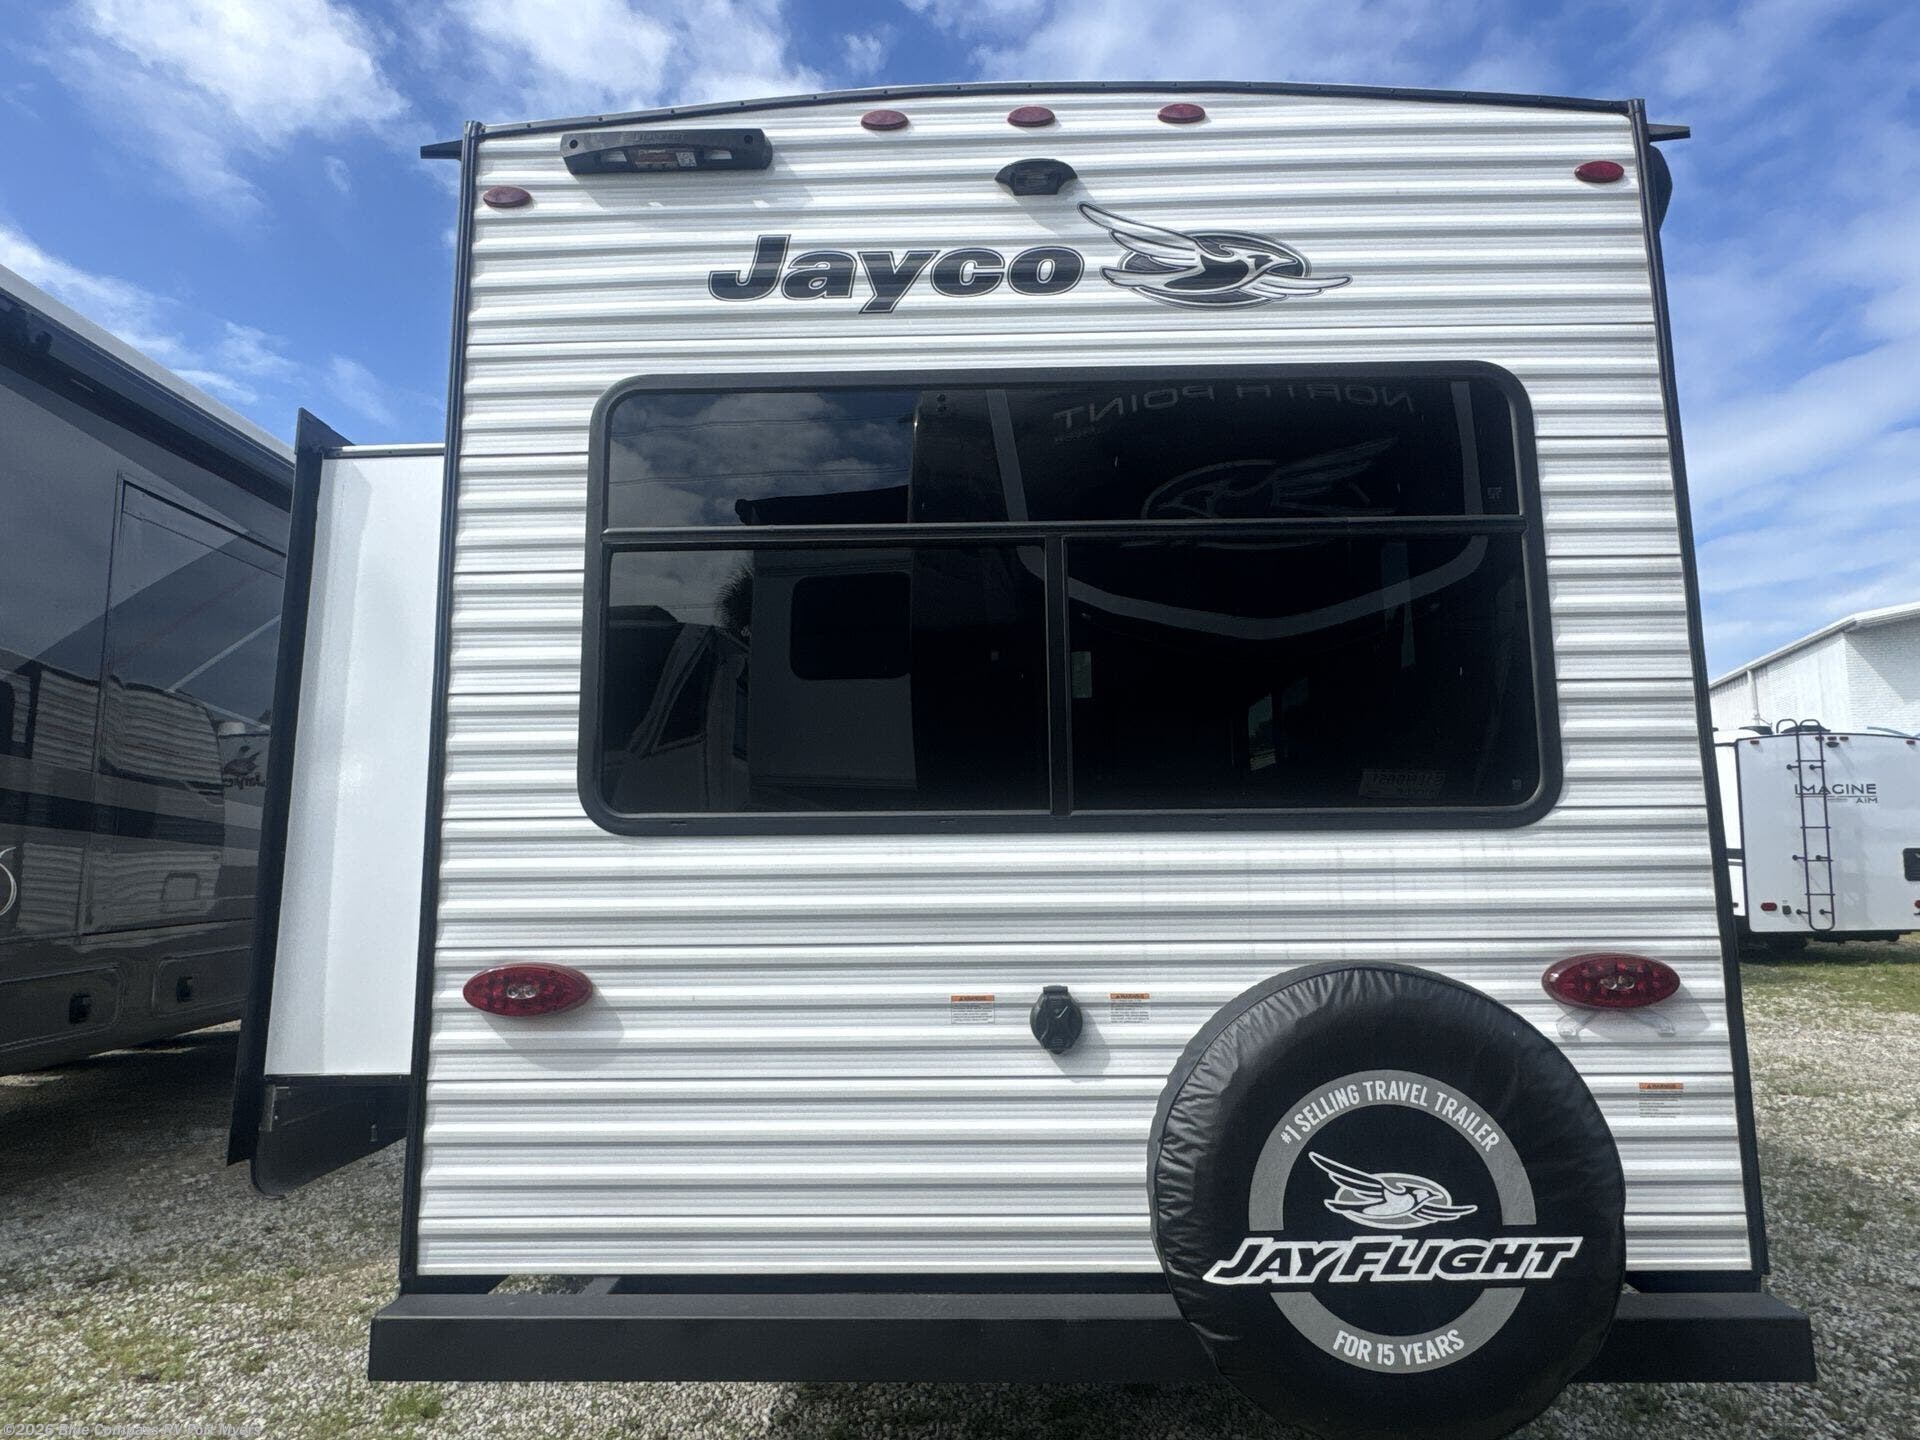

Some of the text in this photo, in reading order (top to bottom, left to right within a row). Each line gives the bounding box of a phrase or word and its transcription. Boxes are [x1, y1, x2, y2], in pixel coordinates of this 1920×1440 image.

[708, 234, 1086, 314] Jayco
[1795, 783, 1877, 795] IMAGINE
[1280, 1080, 1500, 1153] #1 SELLING TRAVEL TRAILER
[1332, 1329, 1465, 1366] FOR 15 YEARS
